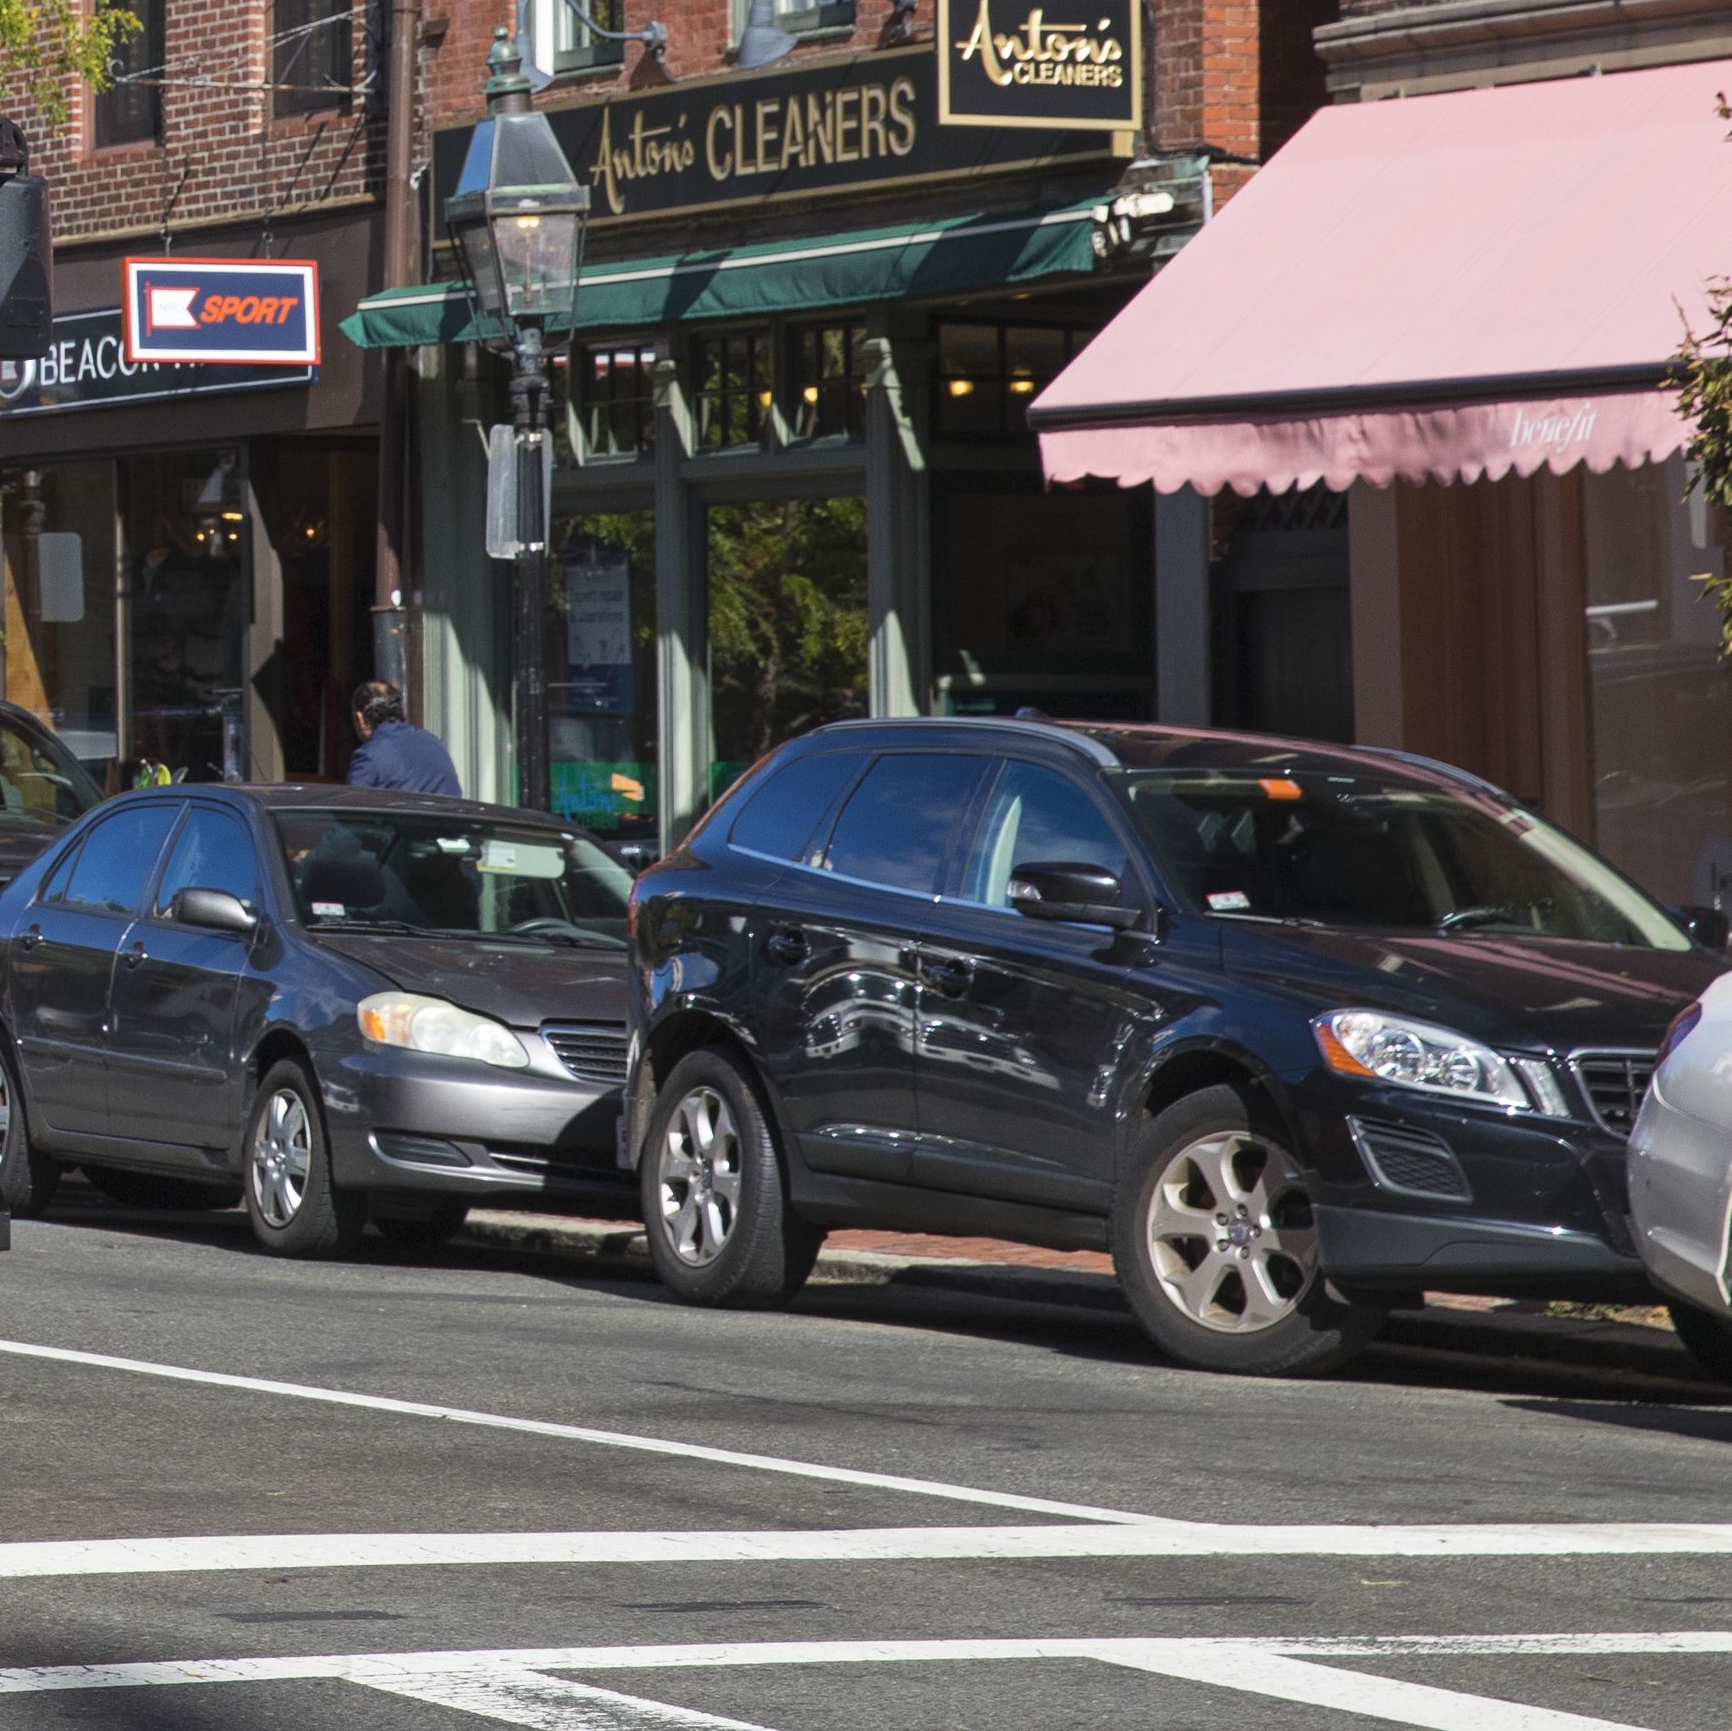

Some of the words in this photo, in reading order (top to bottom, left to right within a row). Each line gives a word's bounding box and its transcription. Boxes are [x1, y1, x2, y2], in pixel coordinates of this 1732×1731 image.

[1012, 62, 1124, 88] CLEANERS
[588, 103, 696, 215] Anton's
[705, 74, 917, 182] CLEANERS
[200, 294, 298, 325] SPORT
[40, 335, 160, 387] BEACO
[1509, 400, 1597, 454] benefit
